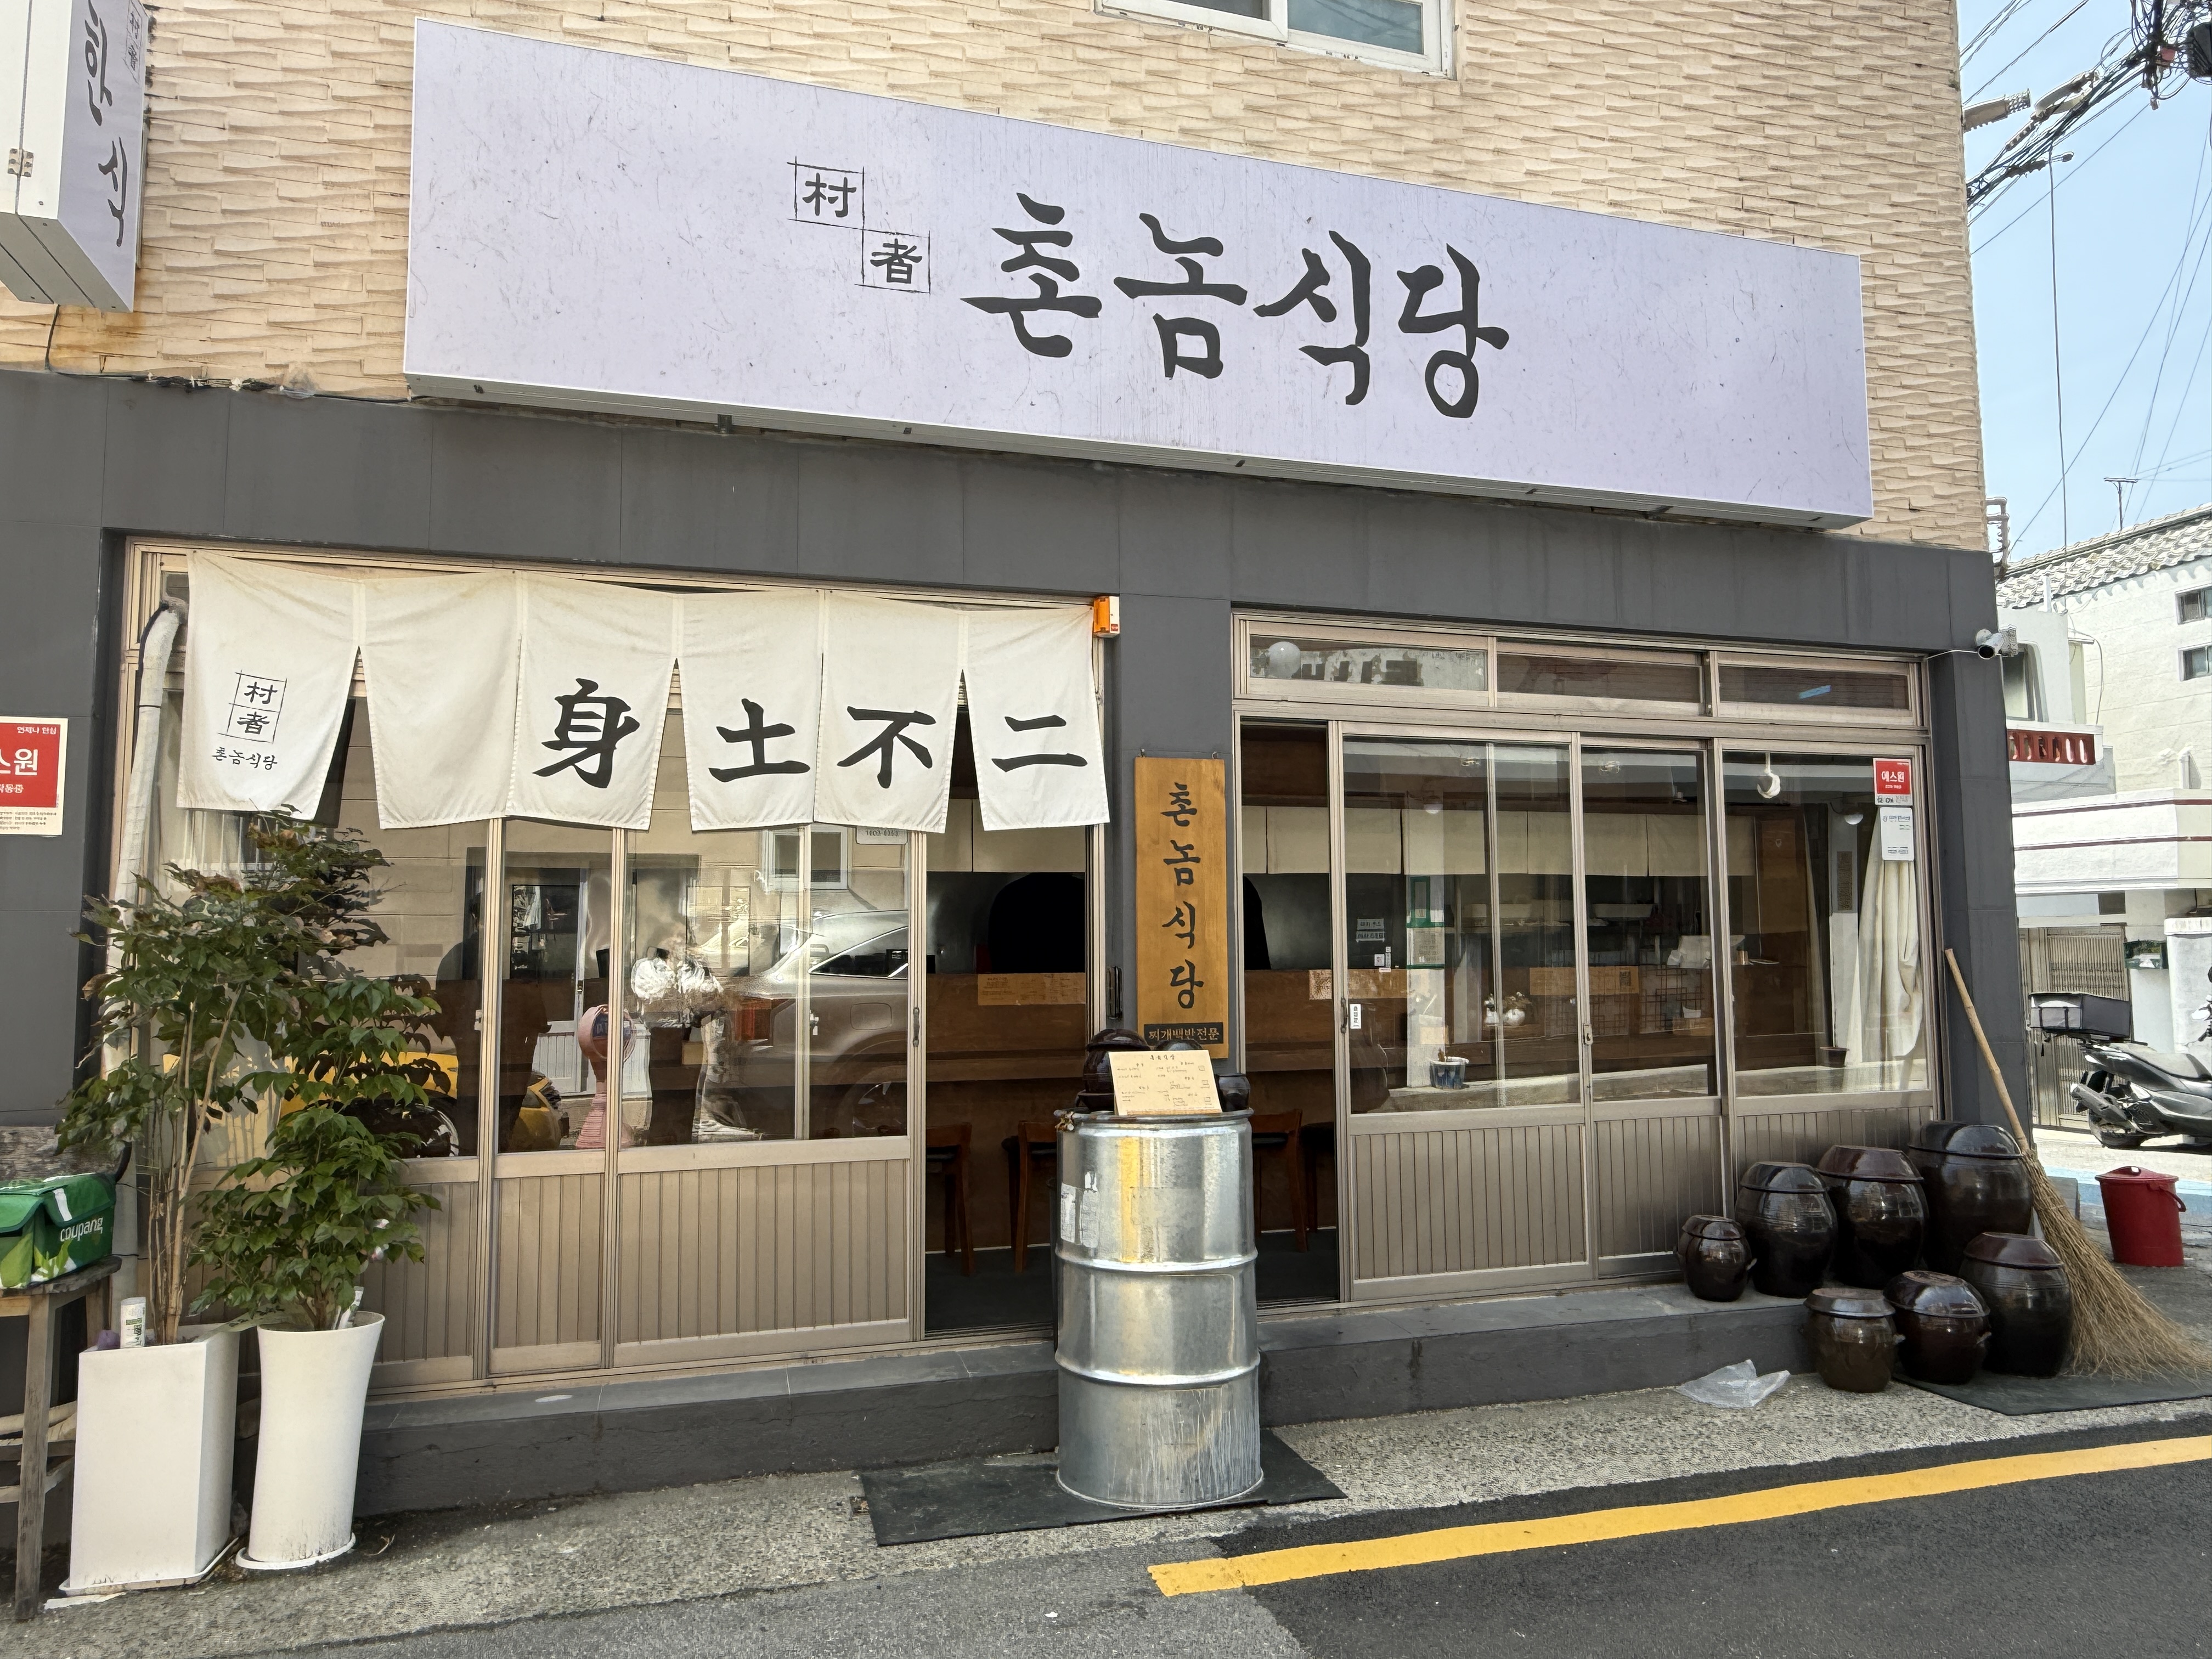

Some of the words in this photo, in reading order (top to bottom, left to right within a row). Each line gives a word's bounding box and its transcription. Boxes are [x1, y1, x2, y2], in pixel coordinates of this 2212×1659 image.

[803, 173, 856, 218] 村
[871, 239, 922, 284] 者
[961, 193, 1509, 419] 촌놈식당
[212, 747, 278, 770] 촌놈식당
[237, 681, 278, 735] 村者
[533, 679, 1087, 788] 身土不二
[1161, 782, 1204, 1009] 촌놈식당
[60, 1217, 103, 1242] coupang
